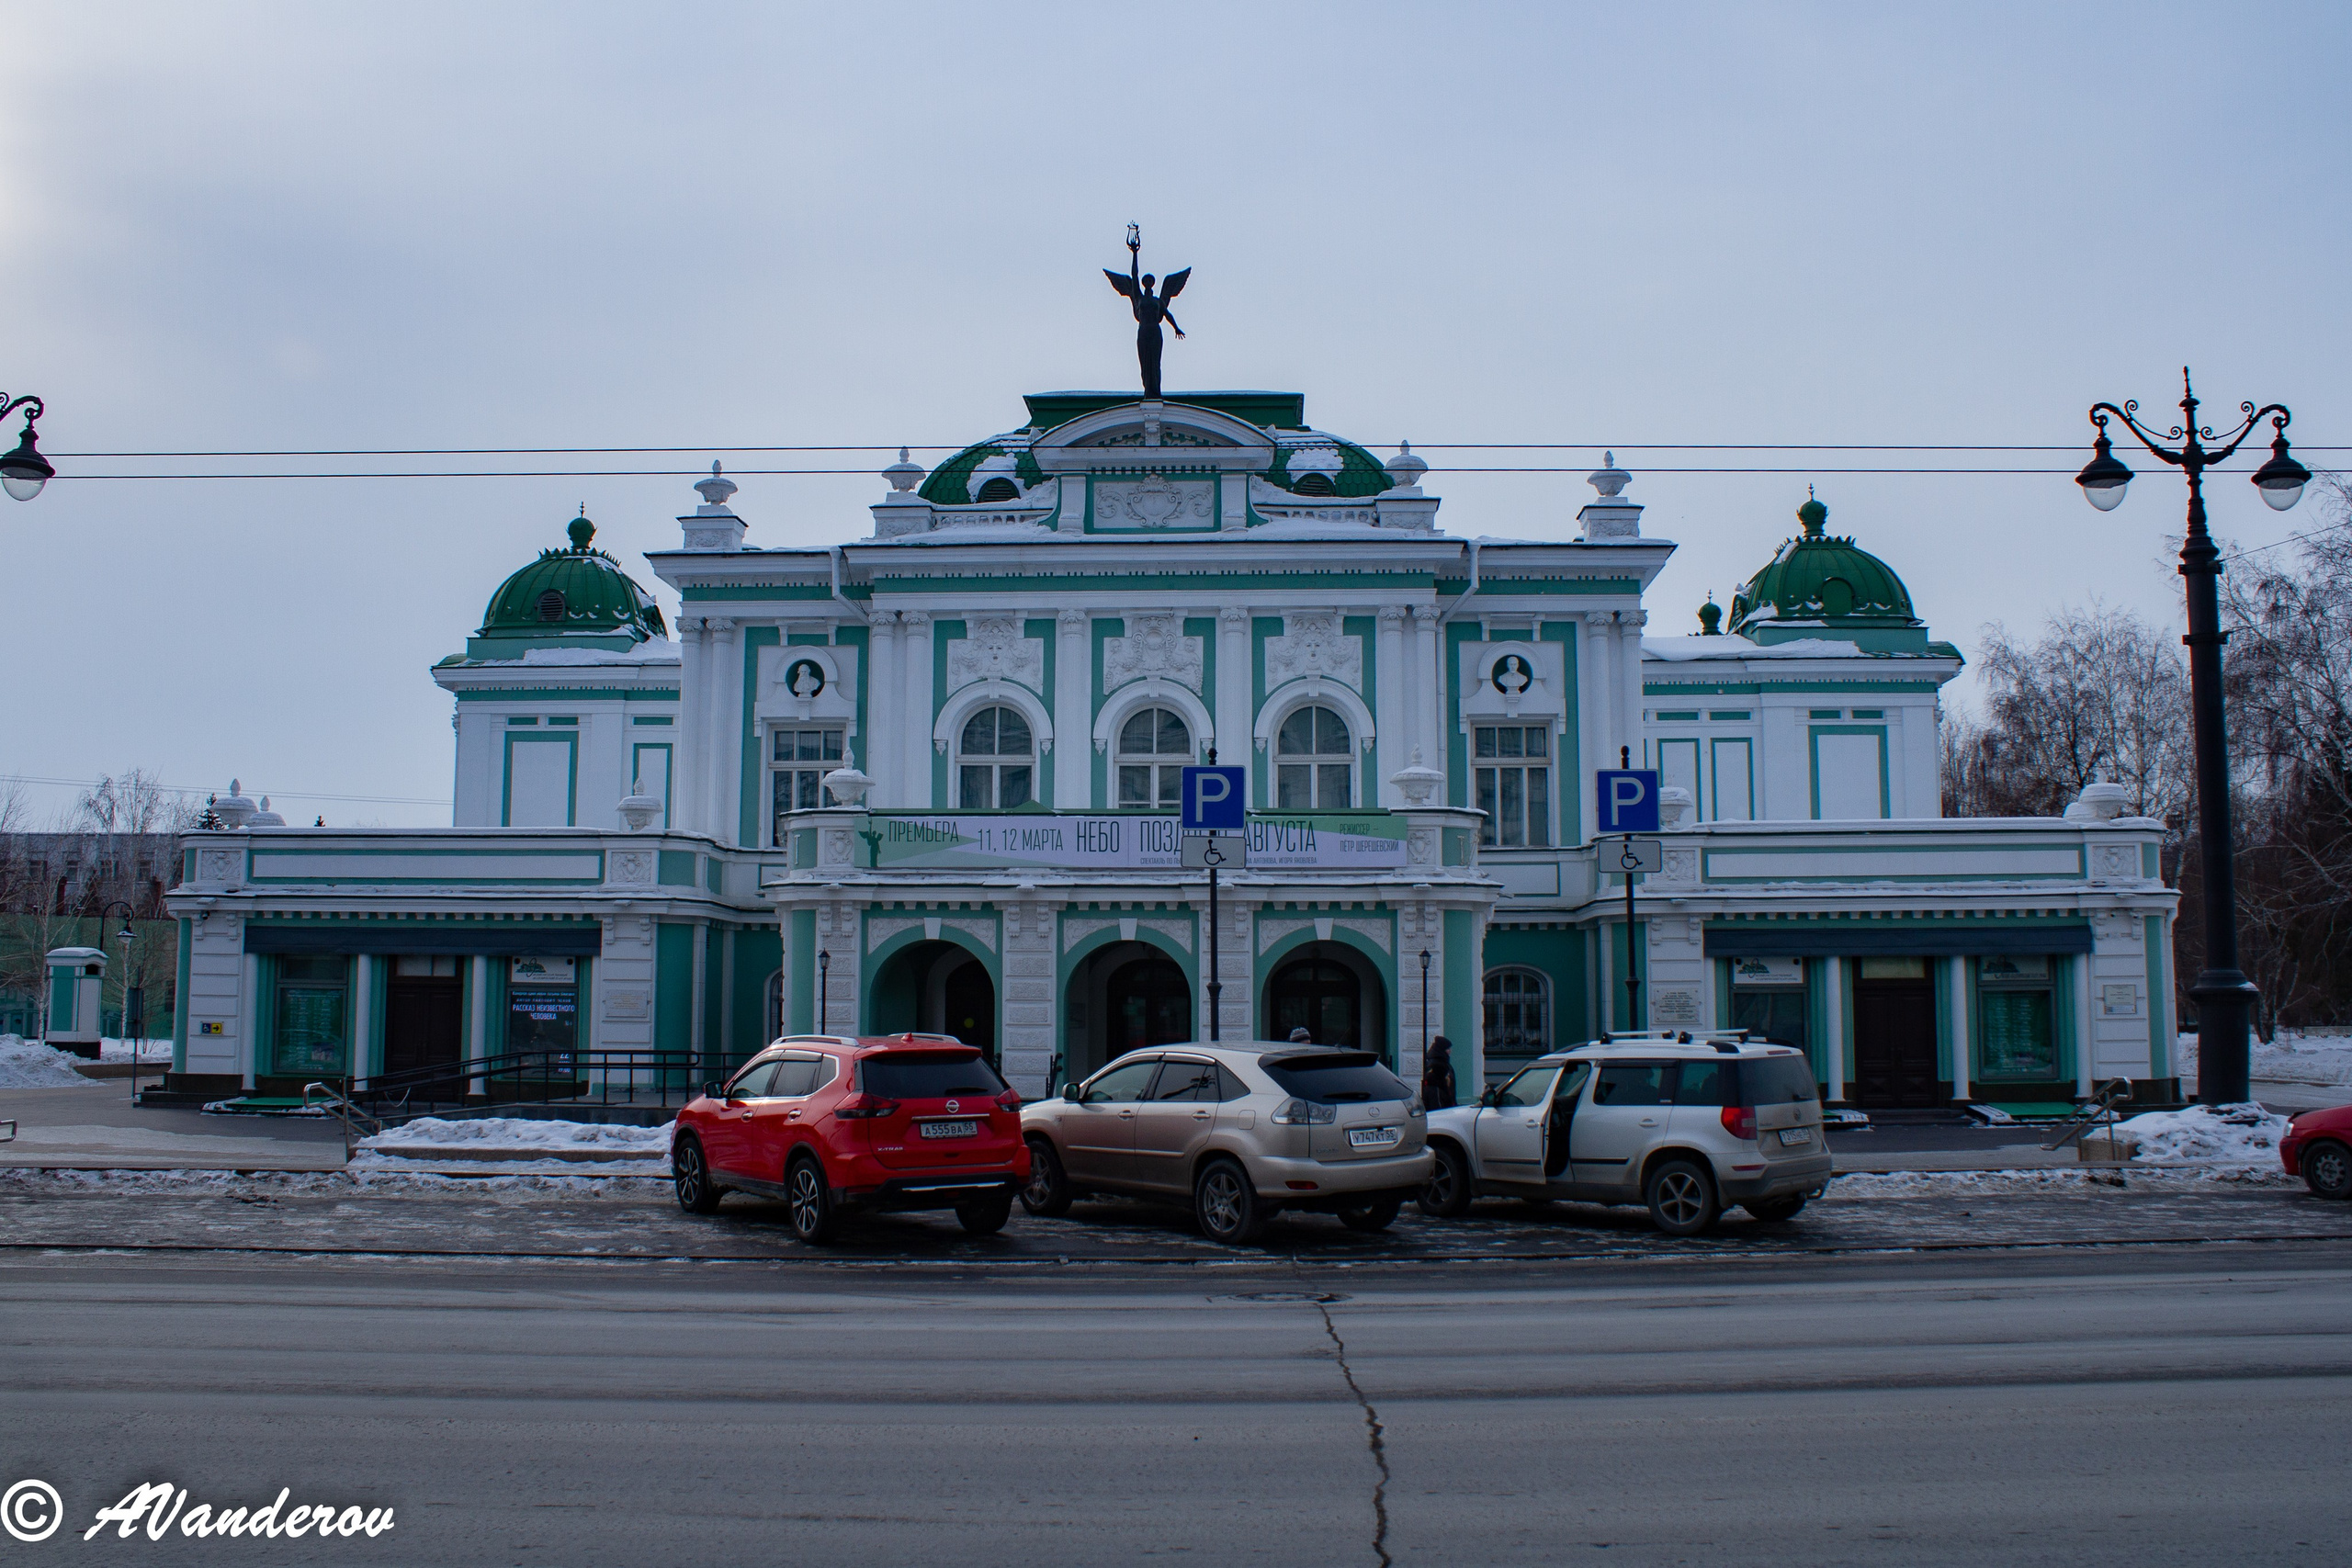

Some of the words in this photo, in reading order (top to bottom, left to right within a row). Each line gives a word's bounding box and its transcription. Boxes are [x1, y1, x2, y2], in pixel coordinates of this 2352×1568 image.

[1195, 773, 1231, 822] P
[1611, 776, 1645, 826] P
[888, 820, 959, 842] ПРЕМЬЕРА
[978, 829, 997, 852] 11,
[1002, 828, 1017, 851] 12
[1022, 829, 1063, 852] МАРТА
[1077, 820, 1120, 852] НЕБО
[1243, 820, 1317, 852] АВГУСТА
[1340, 823, 1371, 835] РЕЖИССЕР
[1356, 839, 1399, 852] ШЕРЕШЕВСКИЙ
[537, 1004, 575, 1012] НЕИЗВЕСТНОГО
